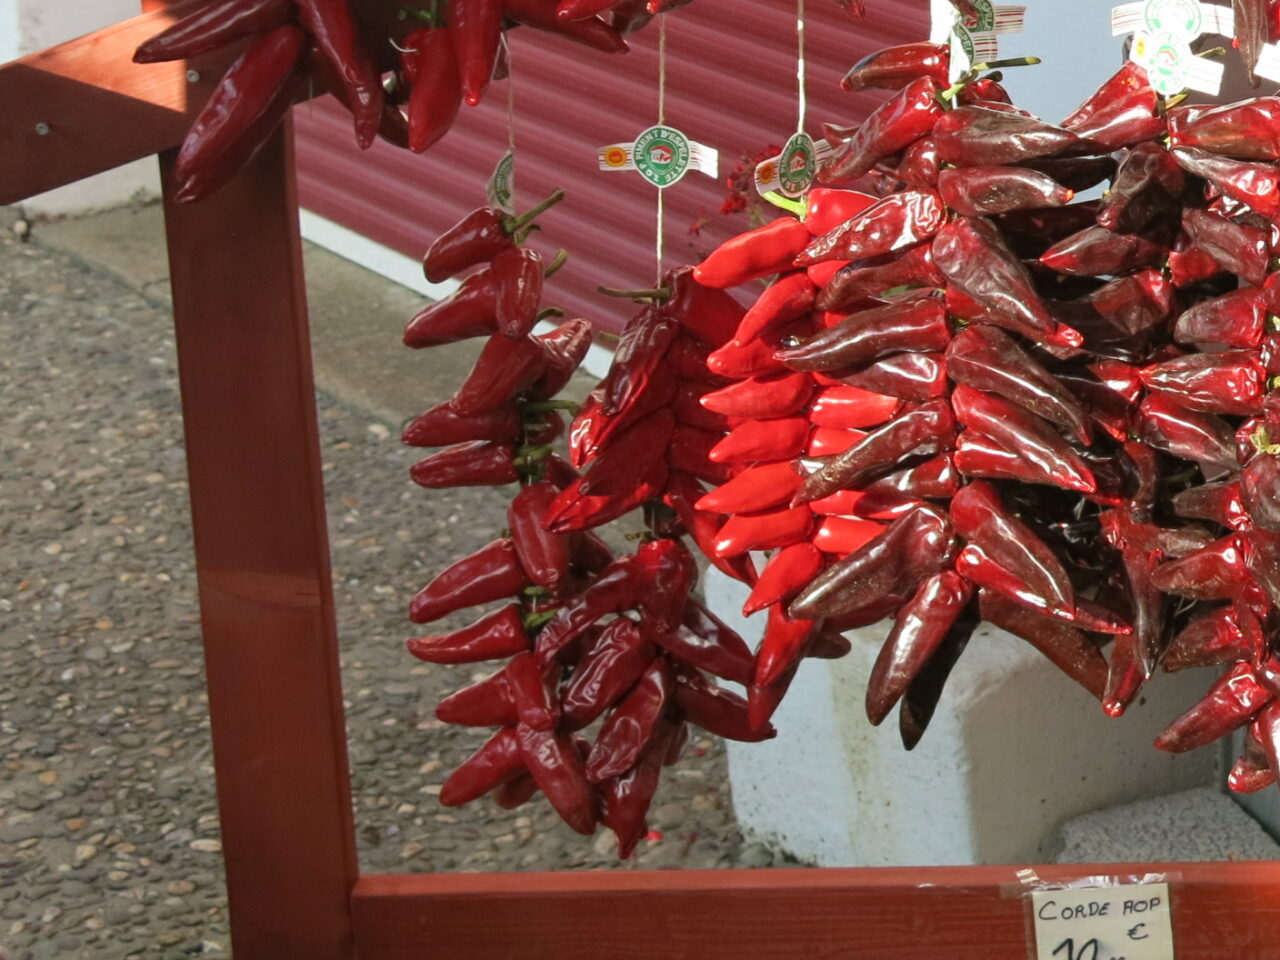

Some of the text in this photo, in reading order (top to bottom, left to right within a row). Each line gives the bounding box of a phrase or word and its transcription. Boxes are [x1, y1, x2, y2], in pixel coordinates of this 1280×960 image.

[1038, 897, 1161, 921] CORDE AOP
[1127, 922, 1150, 941] €
